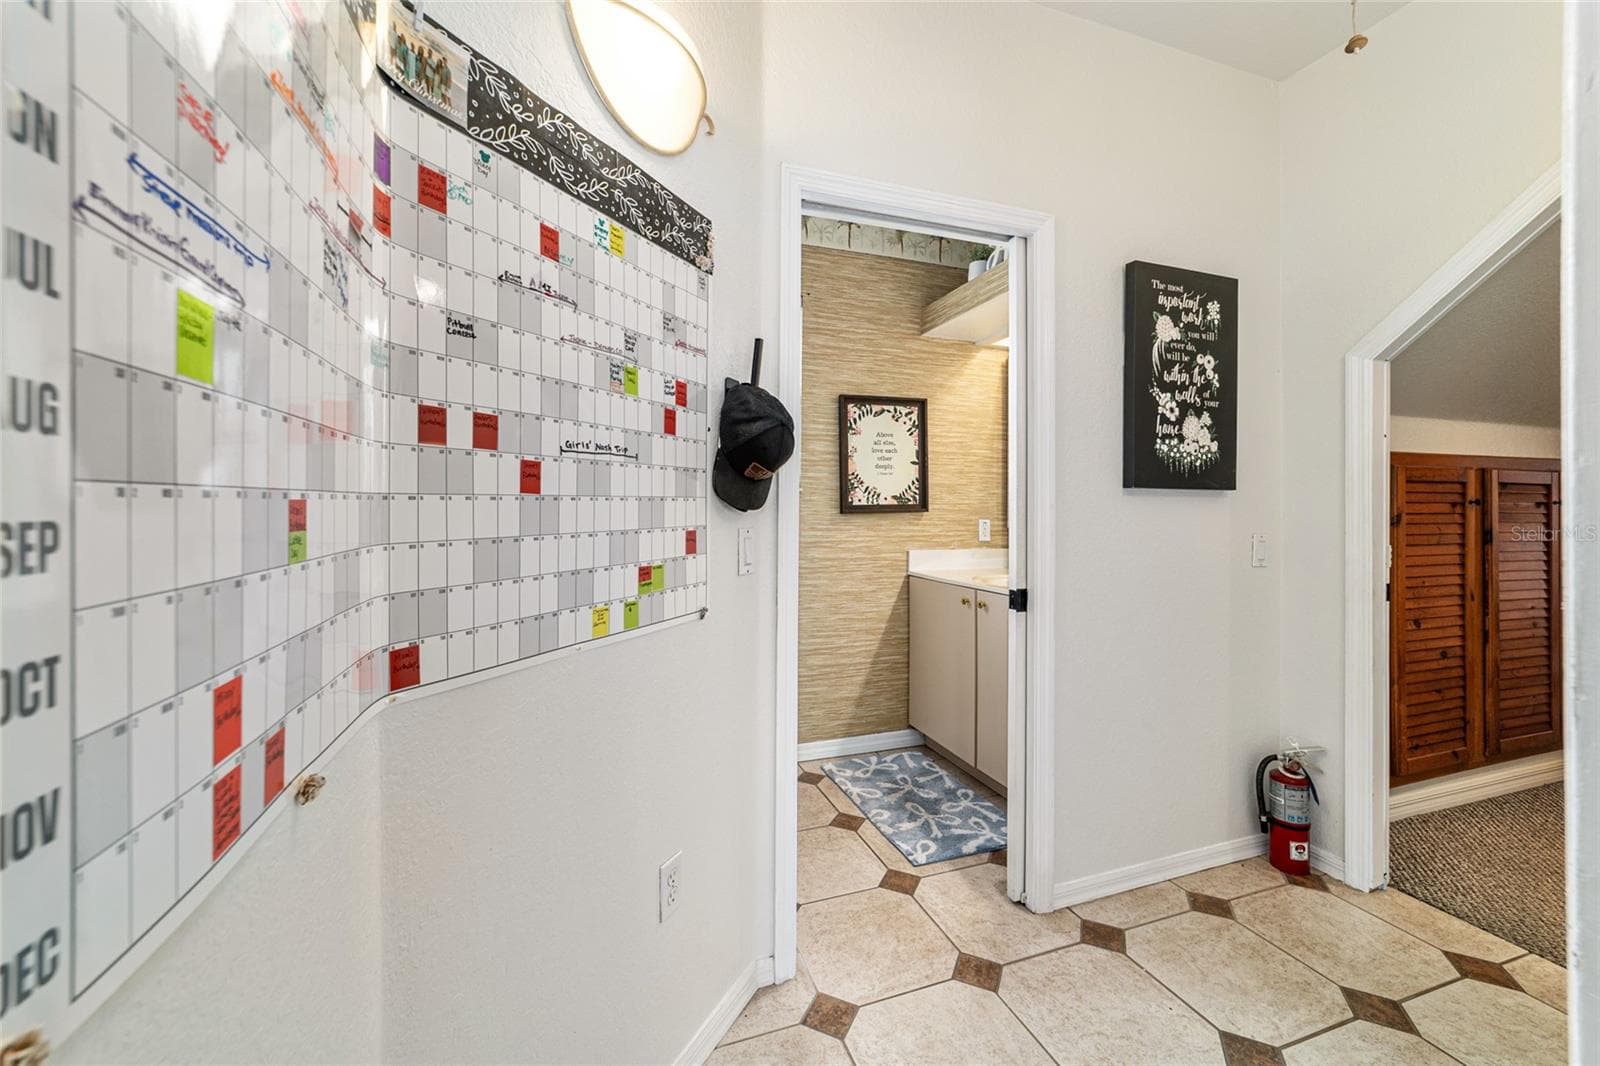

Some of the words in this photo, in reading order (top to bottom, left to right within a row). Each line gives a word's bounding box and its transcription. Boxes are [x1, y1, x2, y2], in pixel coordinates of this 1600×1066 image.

[7, 87, 58, 165] UN
[6, 228, 60, 300] UL
[1151, 279, 1166, 290] The
[1167, 284, 1184, 293] most
[1157, 291, 1207, 312] important
[1181, 307, 1206, 331] work
[1169, 342, 1185, 350] ever
[1187, 331, 1200, 341] you
[1201, 331, 1215, 342] will
[1166, 351, 1180, 361] will
[1182, 352, 1191, 362] be
[1163, 363, 1190, 386] within
[1191, 365, 1207, 387] the
[1175, 385, 1202, 407] walls
[1203, 390, 1211, 399] of
[1204, 400, 1220, 409] your
[2, 376, 60, 436] UG
[614, 445, 629, 455] Trip
[0, 787, 61, 871] OV
